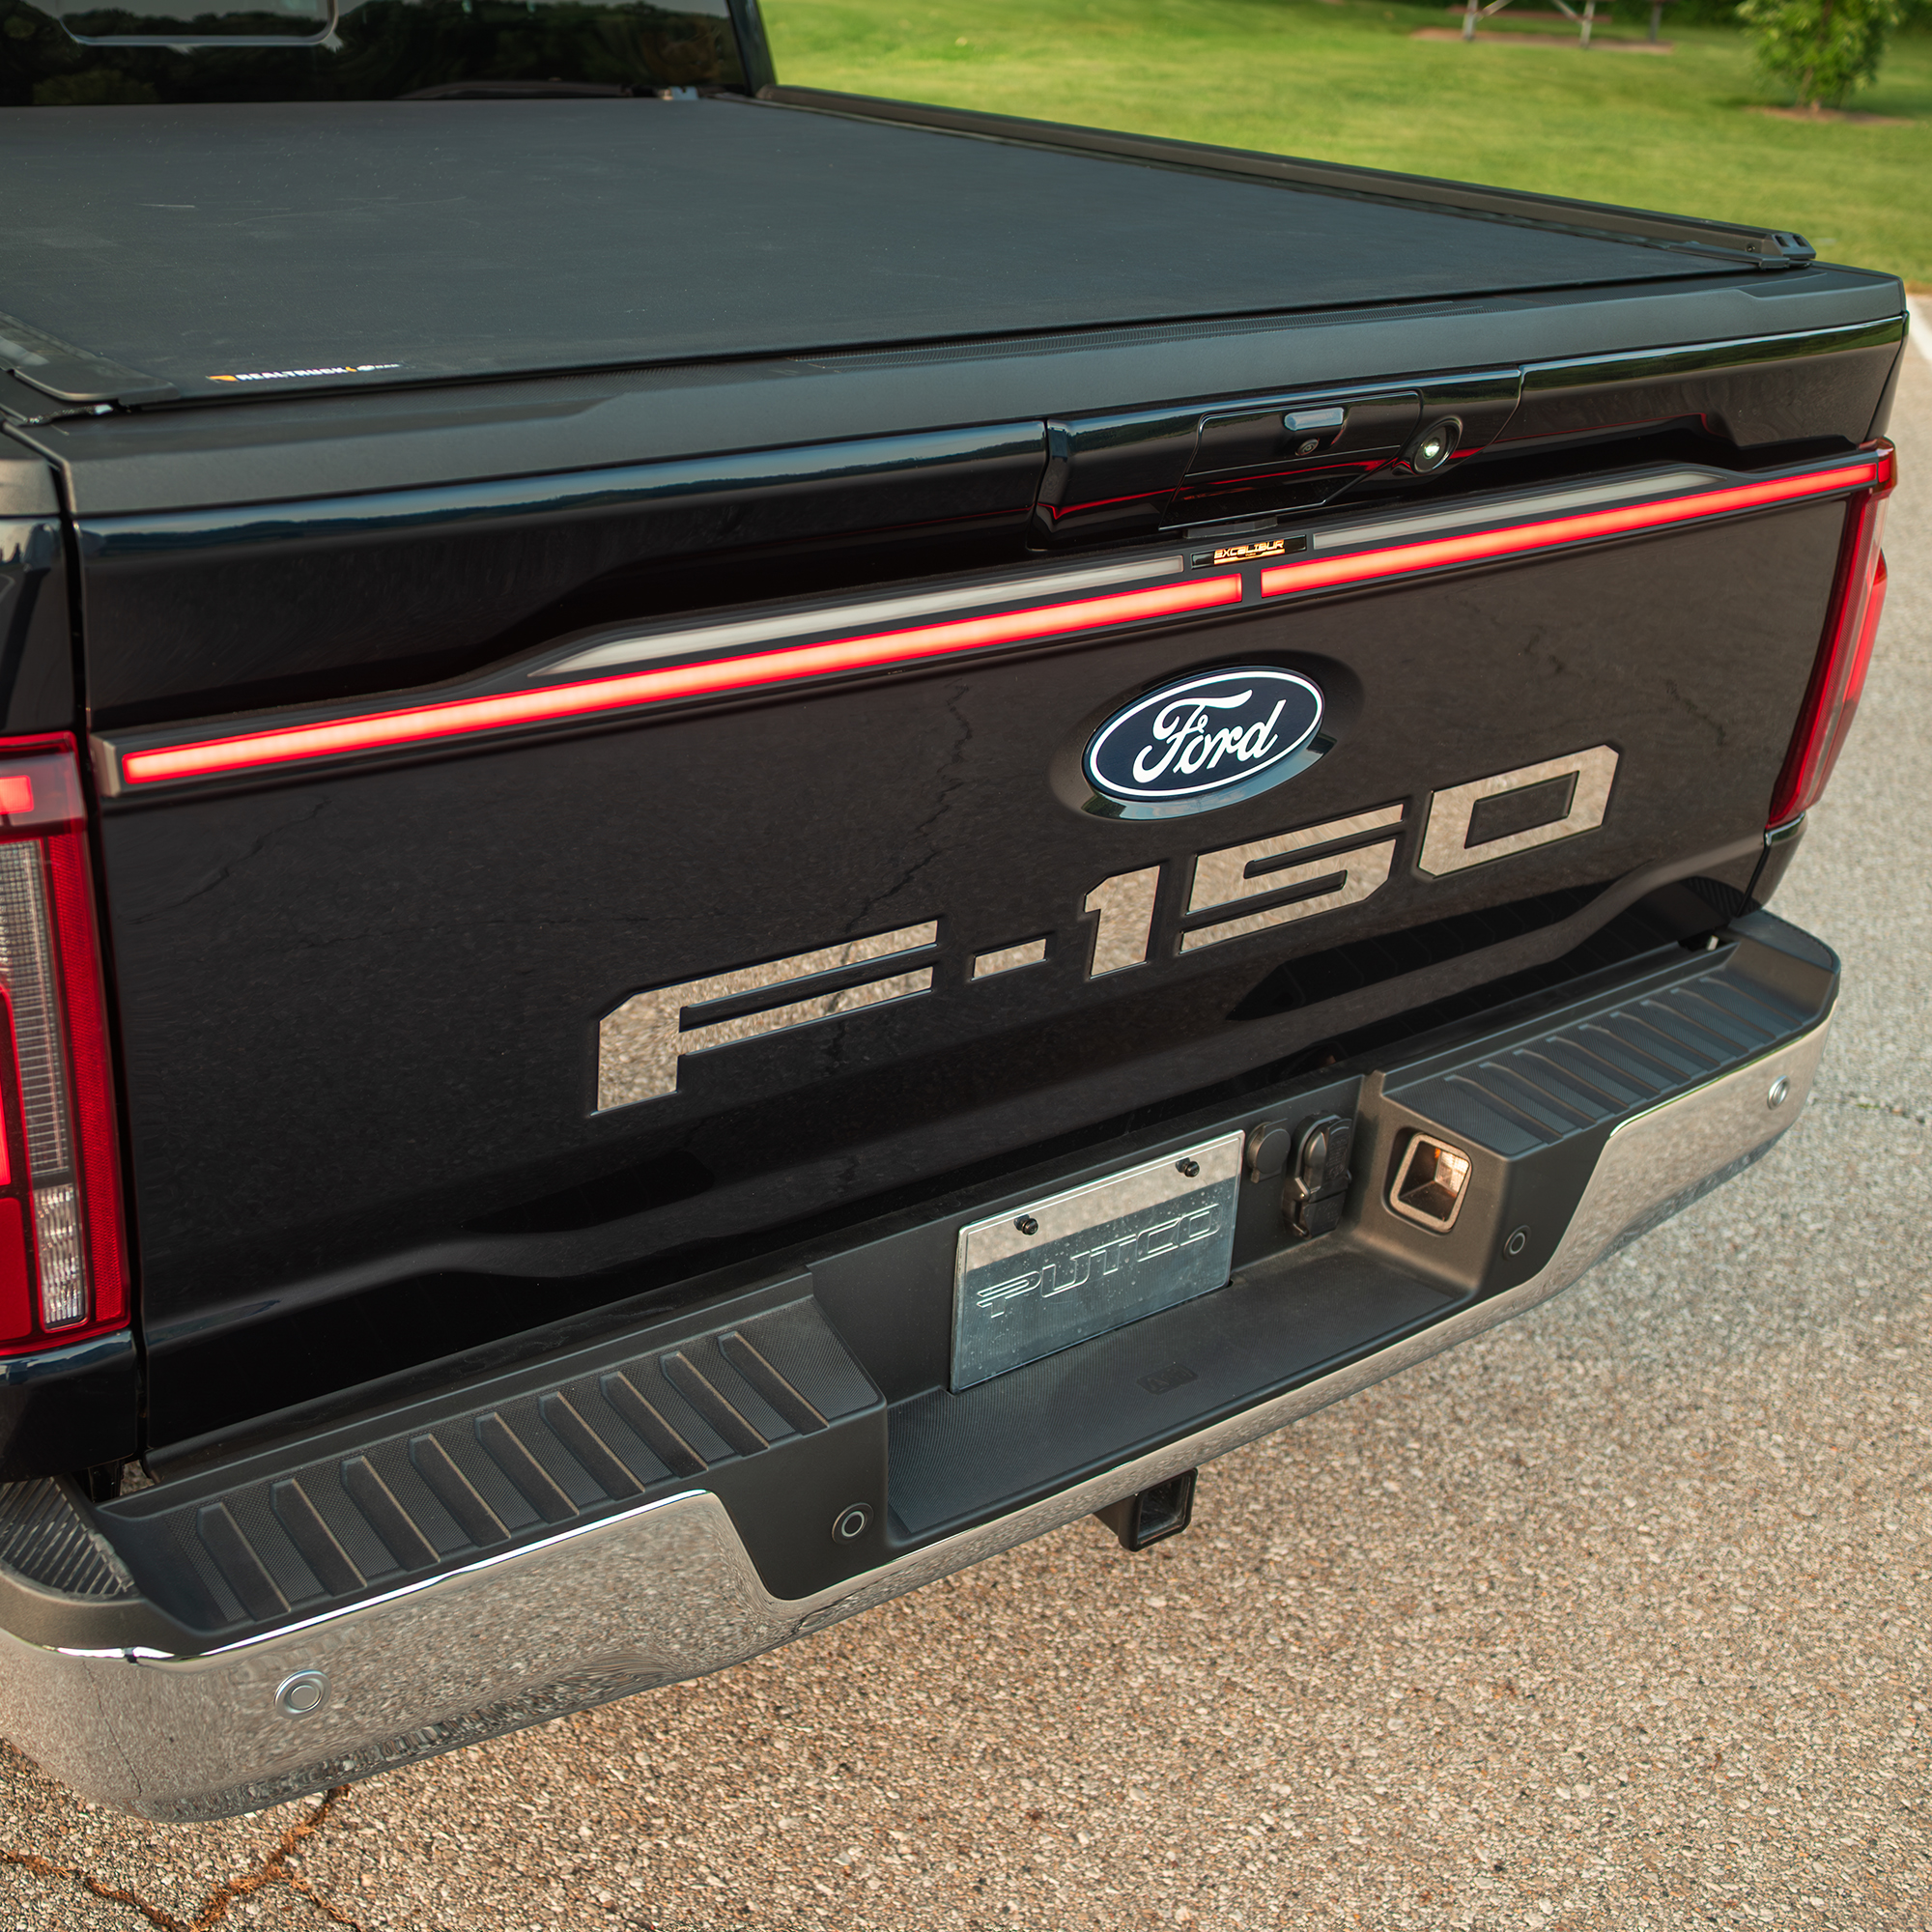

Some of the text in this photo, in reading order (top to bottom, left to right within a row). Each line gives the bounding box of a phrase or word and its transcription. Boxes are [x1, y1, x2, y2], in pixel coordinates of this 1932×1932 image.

[1214, 539, 1285, 558] EXCALIBUR
[1132, 689, 1287, 783] Ford
[592, 744, 1620, 1116] F-150
[976, 1203, 1223, 1319] PUTCO
